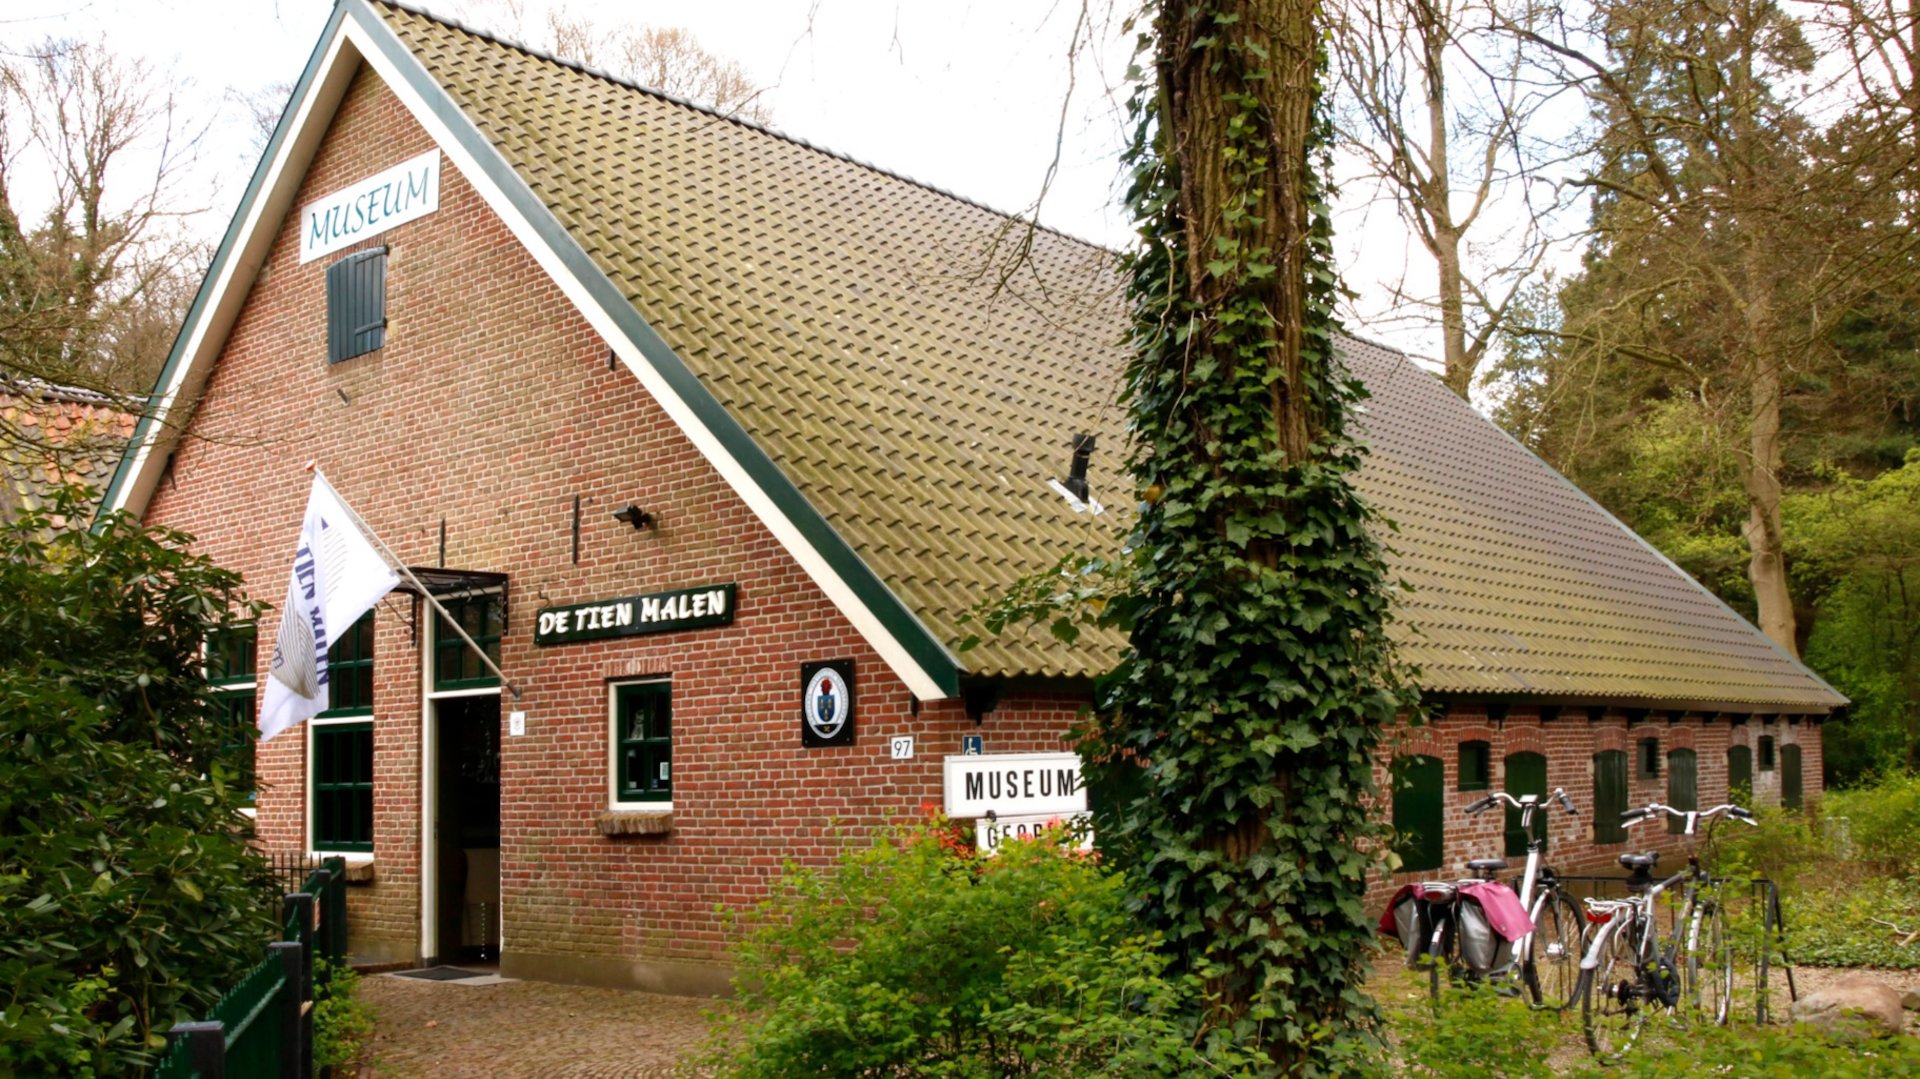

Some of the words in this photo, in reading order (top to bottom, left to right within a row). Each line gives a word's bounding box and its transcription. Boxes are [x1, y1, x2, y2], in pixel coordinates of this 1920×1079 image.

[309, 167, 429, 249] MUSEUM
[539, 611, 570, 635] DE
[575, 603, 633, 631] TIEN
[641, 590, 726, 623] MALEN
[894, 740, 910, 756] 97
[965, 769, 1074, 800] MUSEUM
